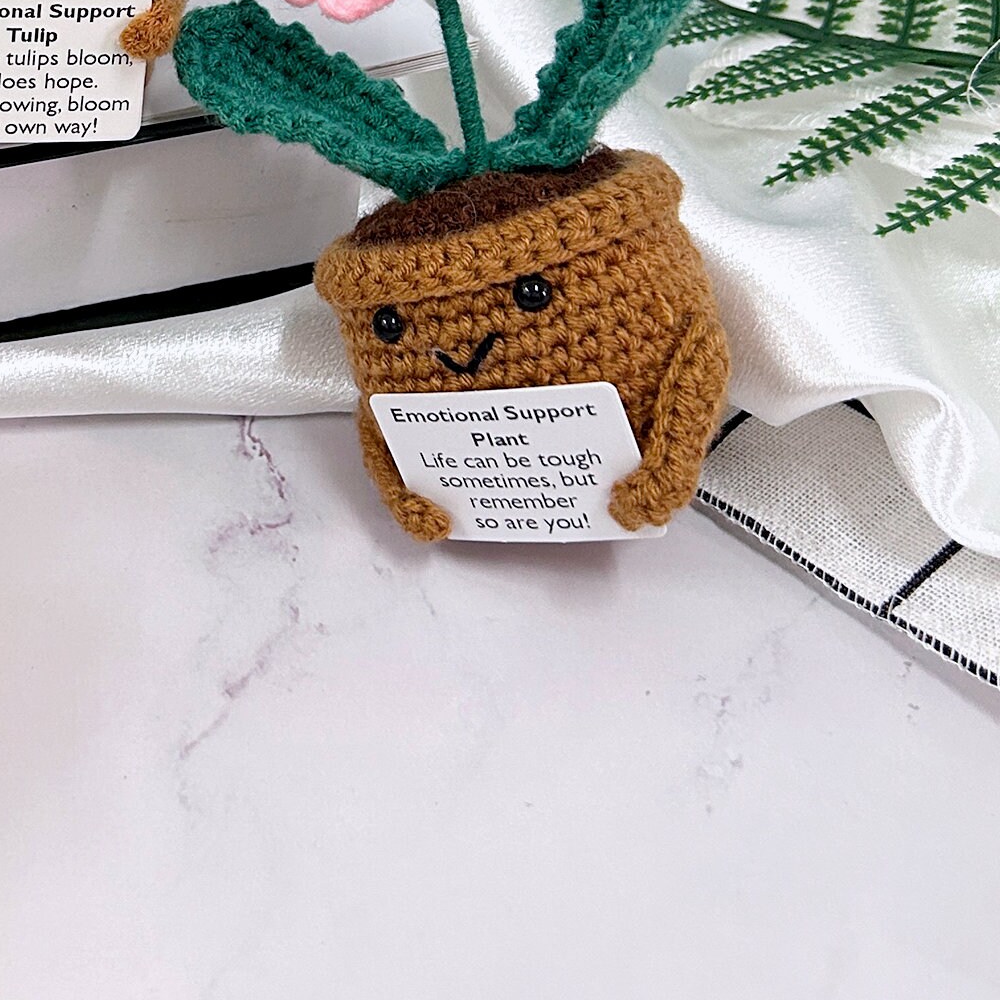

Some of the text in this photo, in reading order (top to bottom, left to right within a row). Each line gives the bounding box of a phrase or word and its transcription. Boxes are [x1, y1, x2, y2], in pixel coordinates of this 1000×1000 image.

[49, 3, 136, 23] Support
[6, 27, 58, 48] Tulip
[6, 49, 59, 71] tulips
[66, 47, 134, 67] bloom,
[44, 72, 98, 94] hope.
[67, 95, 130, 112] bloom
[4, 122, 47, 135] own
[54, 117, 98, 138] way!
[390, 403, 597, 424] Emotional Support
[470, 432, 530, 447] Plant
[419, 448, 602, 471] Life can be tough
[439, 471, 598, 489] sometimes, but
[469, 492, 578, 510] remember
[475, 512, 591, 535] so are you!
